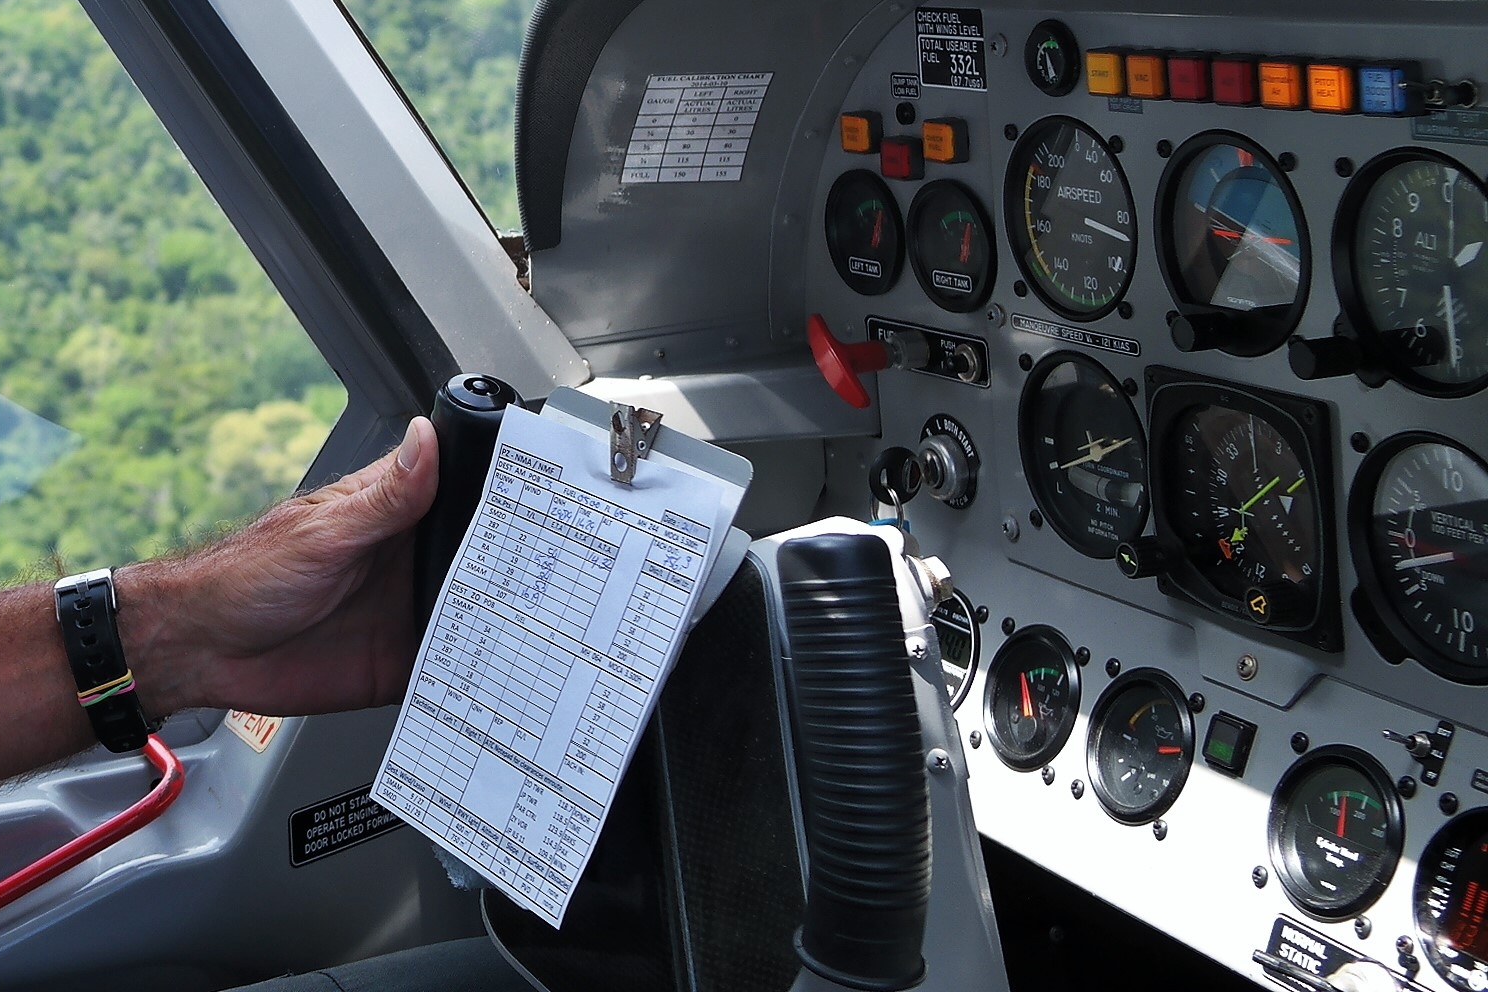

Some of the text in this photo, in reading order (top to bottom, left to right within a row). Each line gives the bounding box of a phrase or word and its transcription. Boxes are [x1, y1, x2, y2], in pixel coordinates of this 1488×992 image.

[917, 12, 961, 24] CHECK FUEL
[918, 24, 980, 36] WITH WINGS LEVEL
[921, 39, 977, 52] TOTAL USEABLE
[922, 52, 980, 75] FUEL 332L
[950, 76, 984, 89] (87.7USG)
[1314, 78, 1335, 86] PITOT
[1317, 90, 1335, 98] HEAT
[1048, 155, 1064, 168] 200
[1085, 151, 1098, 164] 40
[1036, 175, 1051, 189] 180
[1100, 170, 1112, 183] 60
[1058, 185, 1102, 204] AIRSPEED
[1408, 192, 1420, 213] 9
[1117, 210, 1130, 225] 80
[1036, 219, 1052, 234] 160
[1392, 218, 1403, 238] 8
[1072, 233, 1093, 245] KNOTS
[1414, 232, 1436, 250] ALT
[851, 260, 880, 274] LEFT TANK
[1054, 258, 1068, 270] 140
[936, 275, 969, 289] RIGHT TANK
[1084, 276, 1098, 290] 120
[1396, 287, 1407, 308] 7
[1020, 319, 1130, 351] MANOEUVRE SPEED 121 KIAS
[1415, 318, 1427, 338] 6
[940, 340, 956, 350] PUSH
[944, 418, 974, 458] BOTH START
[1226, 442, 1240, 460] 33
[502, 448, 554, 475] PZ NMA NMF
[544, 479, 552, 490] 3
[1216, 468, 1228, 486] 30
[1442, 468, 1463, 492] 10
[495, 472, 514, 485] RUNW
[524, 482, 542, 496] WIND
[554, 496, 566, 506] QNH
[1056, 482, 1062, 494] L
[498, 460, 679, 542] DEST AM POB FUEL MOCA
[489, 508, 506, 520] SMZO
[1096, 503, 1120, 518] 2 MIN.
[1217, 506, 1230, 518] W
[1430, 510, 1476, 532] VERTICAL
[518, 534, 527, 542] 22
[1088, 526, 1119, 540] INFORMATION
[1404, 528, 1416, 548] 0
[1446, 526, 1484, 544] FEET PER
[484, 531, 522, 554] BDY 11
[482, 543, 518, 564] RA 19
[478, 554, 514, 575] KA 29
[466, 562, 510, 587] SMAM 26
[1422, 570, 1444, 584] DOWN
[1420, 580, 1428, 592] 5
[496, 590, 507, 600] 107
[452, 598, 474, 612] SMAM
[451, 584, 622, 672] DEST ZO POB FUEL MOCA
[454, 612, 492, 634] KA 34
[1453, 608, 1474, 632] 10
[451, 623, 487, 645] RA 34
[444, 634, 482, 656] BDY 20
[434, 654, 452, 667] SMZO
[470, 660, 478, 668] 12
[420, 675, 504, 726] APPR WIND QNH REP
[460, 682, 586, 760] 118 200
[443, 714, 543, 780] Left Right clearances
[386, 777, 402, 791] SMAM
[533, 784, 544, 795] TWR
[382, 788, 397, 802] SMZO
[314, 794, 372, 822] DO NOT STAR
[515, 803, 525, 814] PAR
[526, 794, 581, 834] TWR TIME
[306, 804, 379, 839] OPERATE ENGINE
[517, 820, 528, 830] VOR
[305, 813, 396, 854] DOOR LOCKED FORWA
[439, 797, 545, 872] Wind RWY Altitude Slope Surface
[552, 858, 566, 871] WIND
[1280, 925, 1328, 960] NORMAL
[1279, 943, 1322, 974] STATIC
